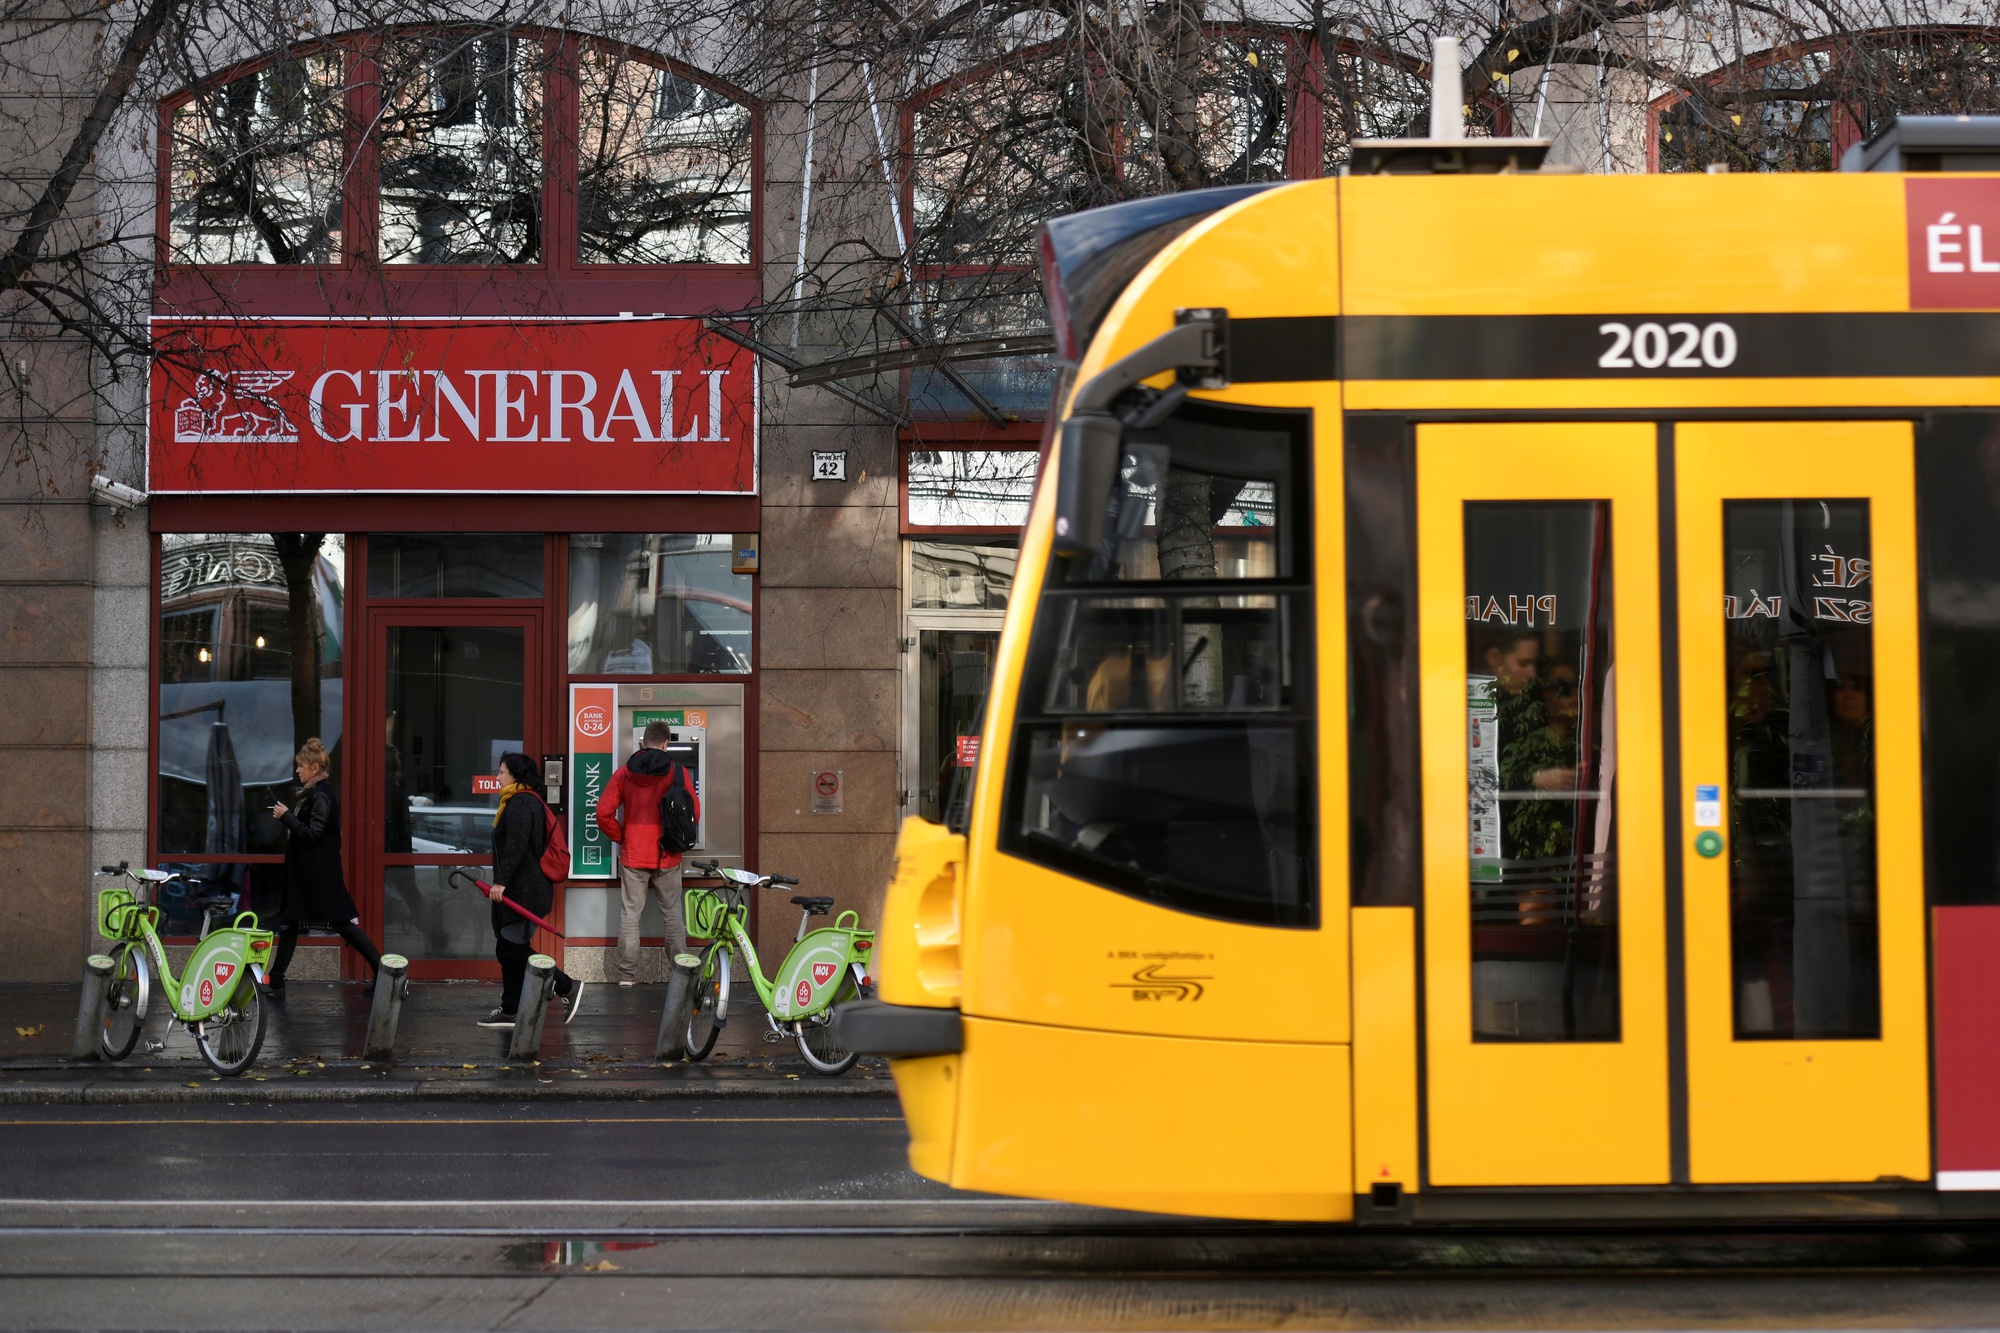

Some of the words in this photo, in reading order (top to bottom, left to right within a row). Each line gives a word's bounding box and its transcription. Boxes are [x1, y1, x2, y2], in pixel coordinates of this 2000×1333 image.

[1926, 212, 2000, 273] ÉL
[1598, 321, 1738, 369] 2020
[308, 368, 731, 443] GENERALI
[818, 462, 838, 476] 42
[583, 722, 604, 731] 0-24
[585, 761, 600, 808] BANK
[216, 965, 229, 976] MOL
[814, 965, 829, 977] MOL
